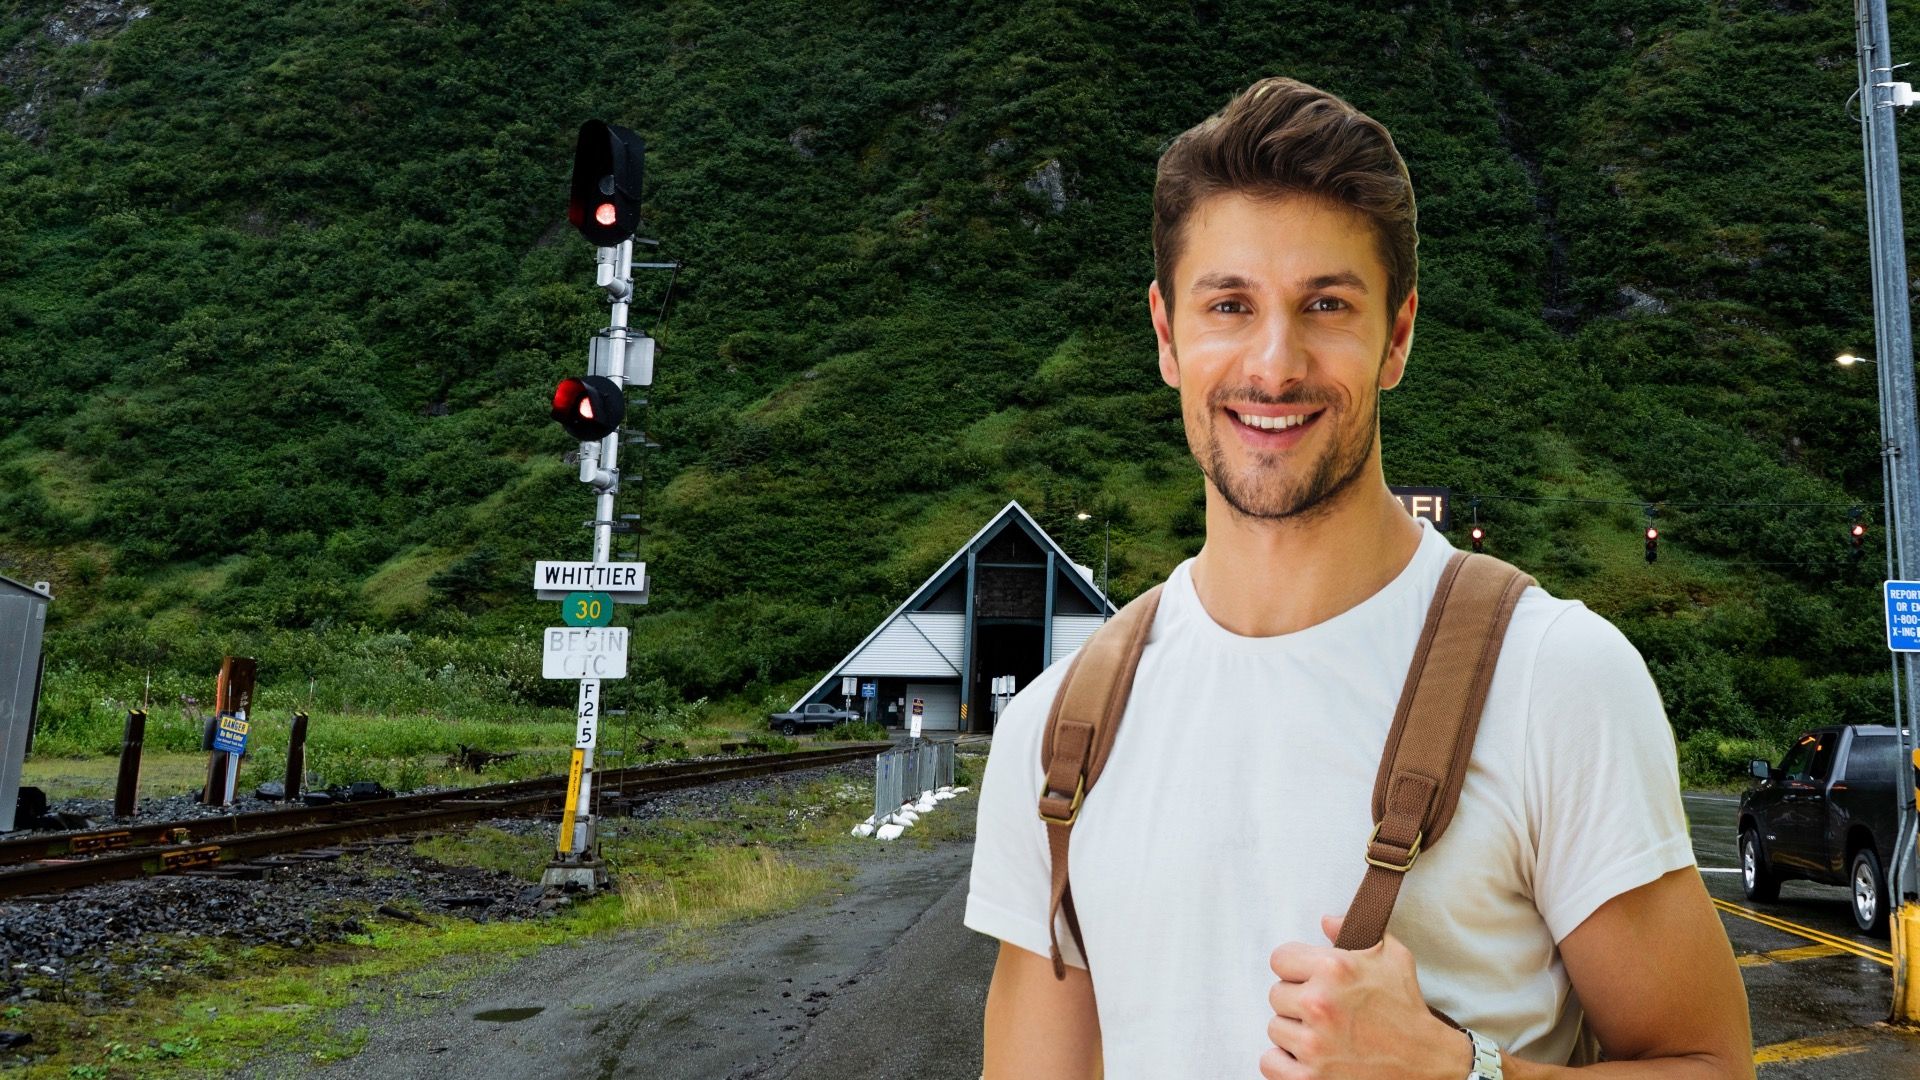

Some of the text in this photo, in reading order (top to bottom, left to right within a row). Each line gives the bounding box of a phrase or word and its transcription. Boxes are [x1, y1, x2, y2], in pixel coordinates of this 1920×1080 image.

[545, 566, 637, 586] WHITTIER
[1890, 589, 1920, 600] REPORT
[575, 600, 601, 619] 30
[1896, 602, 1908, 612] OR
[1892, 626, 1916, 637] X-ING
[550, 631, 623, 652] BEGIN
[563, 654, 607, 676] CTC
[223, 718, 246, 733] DANGER
